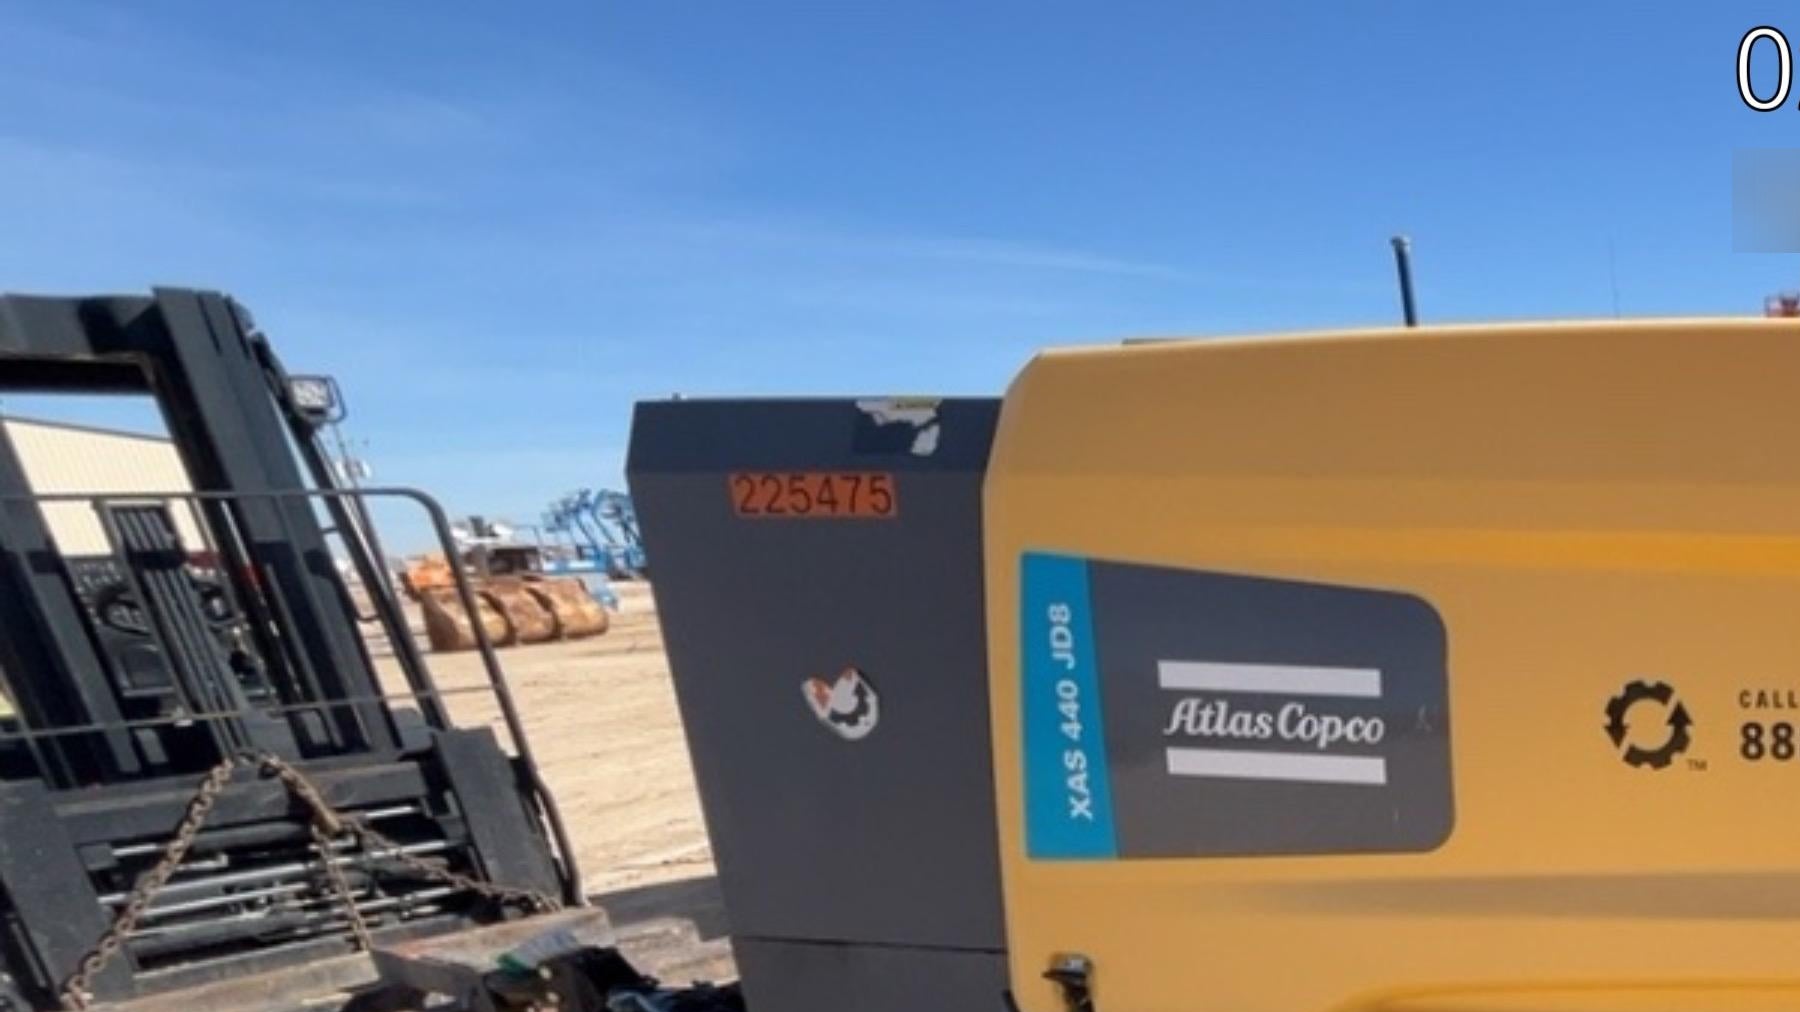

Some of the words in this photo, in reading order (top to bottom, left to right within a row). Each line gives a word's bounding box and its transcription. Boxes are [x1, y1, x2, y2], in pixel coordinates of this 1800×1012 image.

[733, 474, 893, 515] 225475
[1048, 602, 1077, 669] JD8
[1055, 679, 1082, 741] 440
[1163, 697, 1274, 739] Atlas
[1276, 702, 1385, 749] Copco
[1738, 689, 1799, 709] CALL
[1062, 748, 1093, 821] XAS
